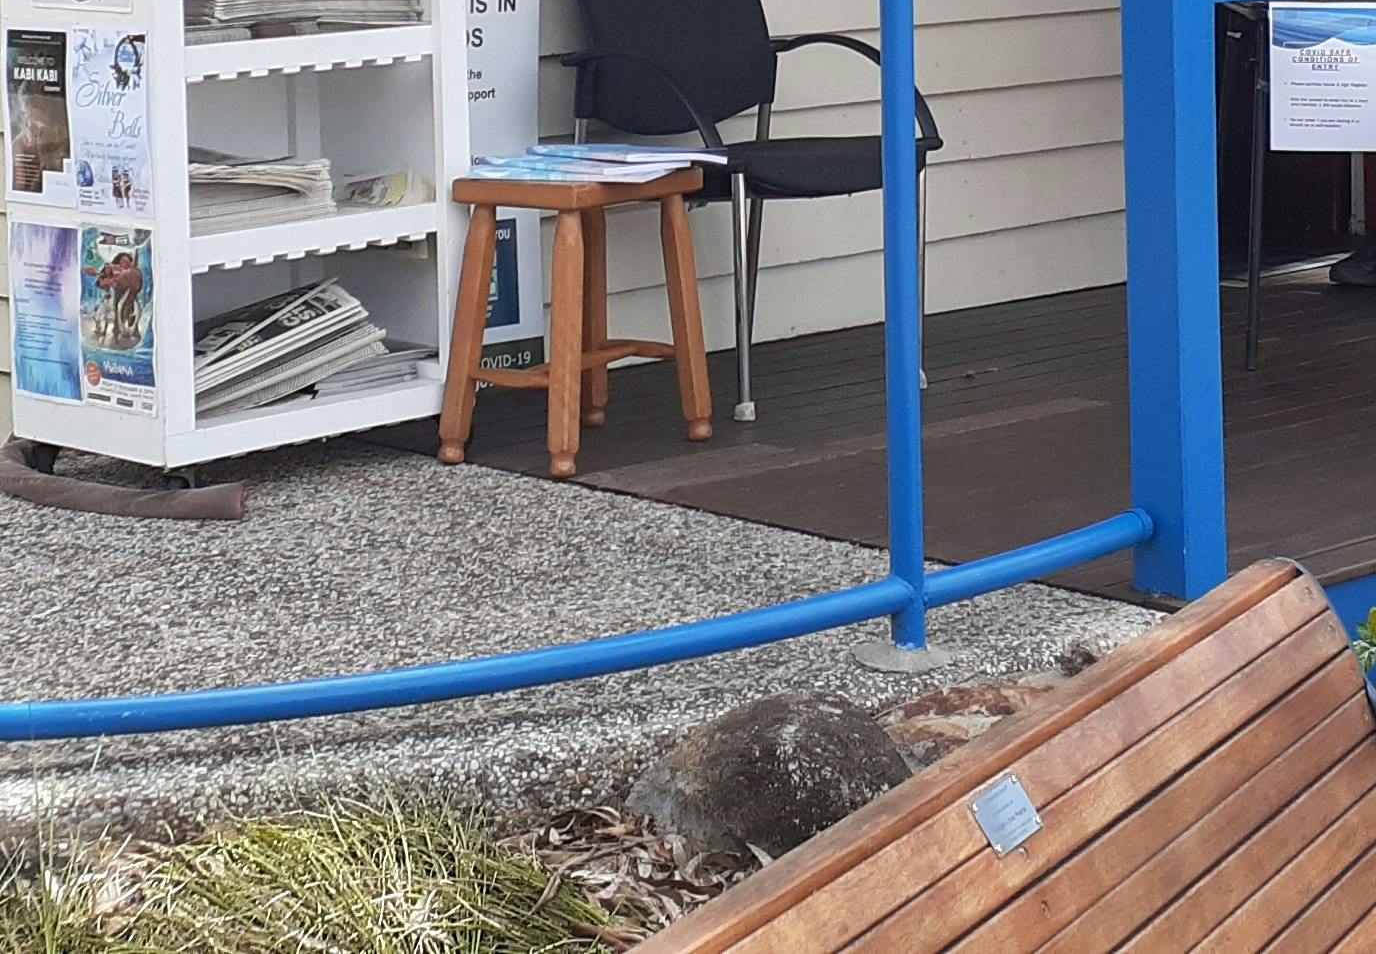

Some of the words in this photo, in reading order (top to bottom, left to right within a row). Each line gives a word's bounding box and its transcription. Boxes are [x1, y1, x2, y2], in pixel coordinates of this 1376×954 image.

[14, 67, 35, 81] KABI
[37, 68, 58, 82] KABI
[76, 71, 126, 108] Silver
[481, 351, 531, 369] OVID-19
